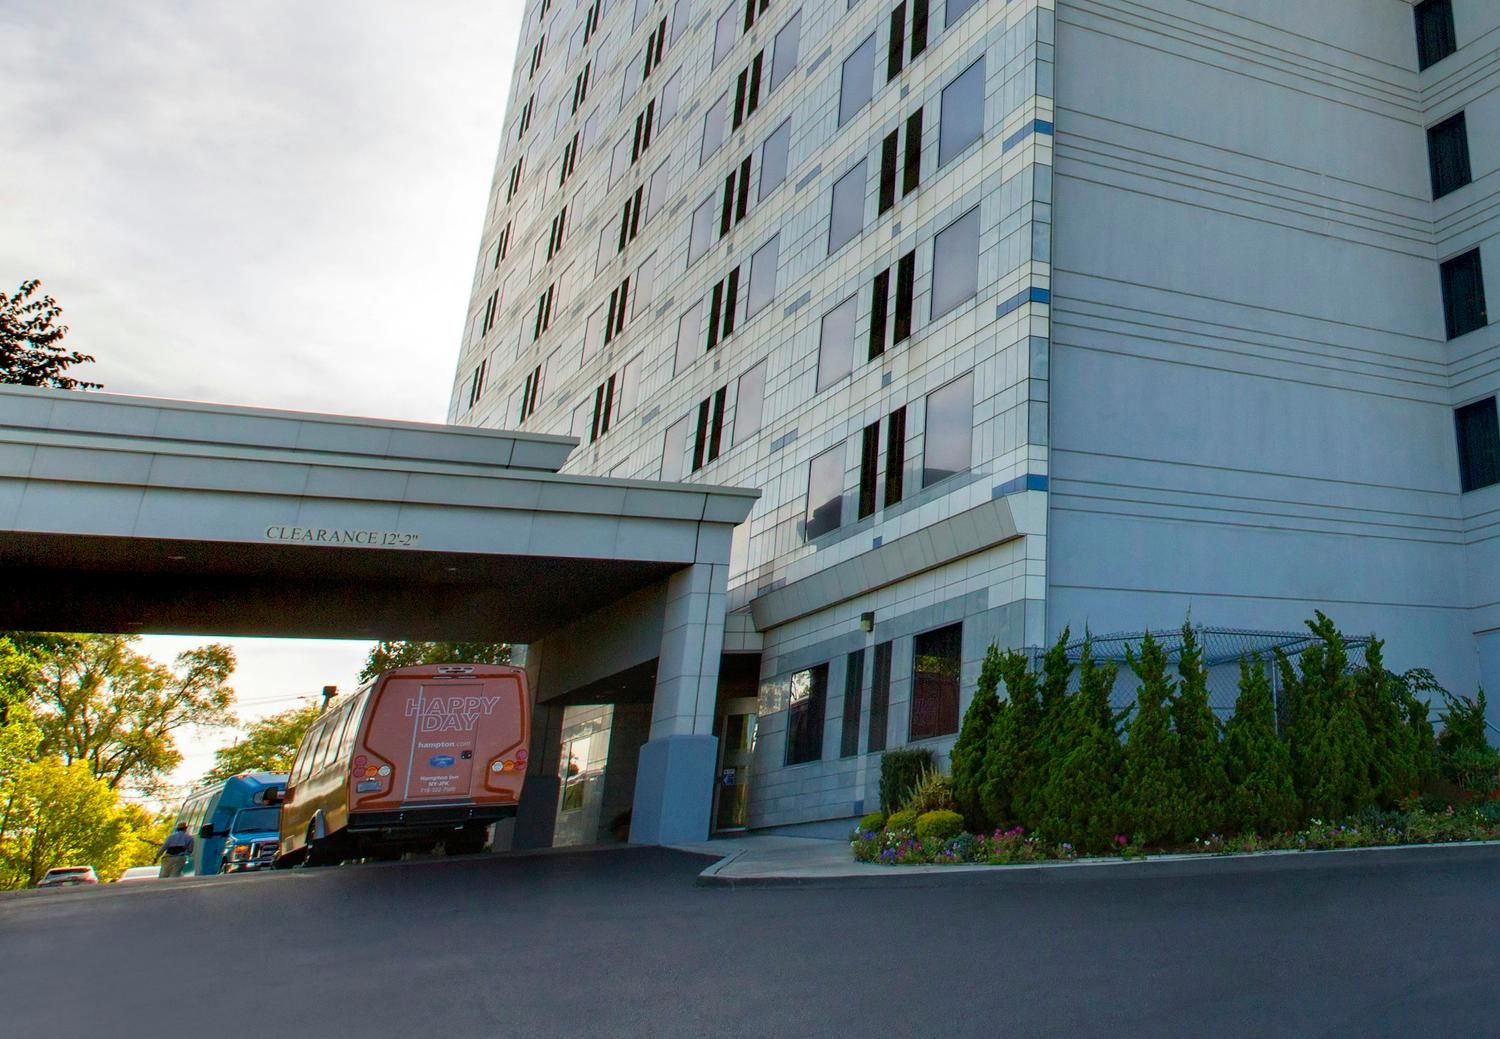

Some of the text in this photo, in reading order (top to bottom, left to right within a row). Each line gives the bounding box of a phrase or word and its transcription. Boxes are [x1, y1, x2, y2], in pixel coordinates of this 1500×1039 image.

[266, 526, 377, 545] CLEARANCE
[405, 697, 500, 716] HAPPY
[421, 712, 480, 732] DAY
